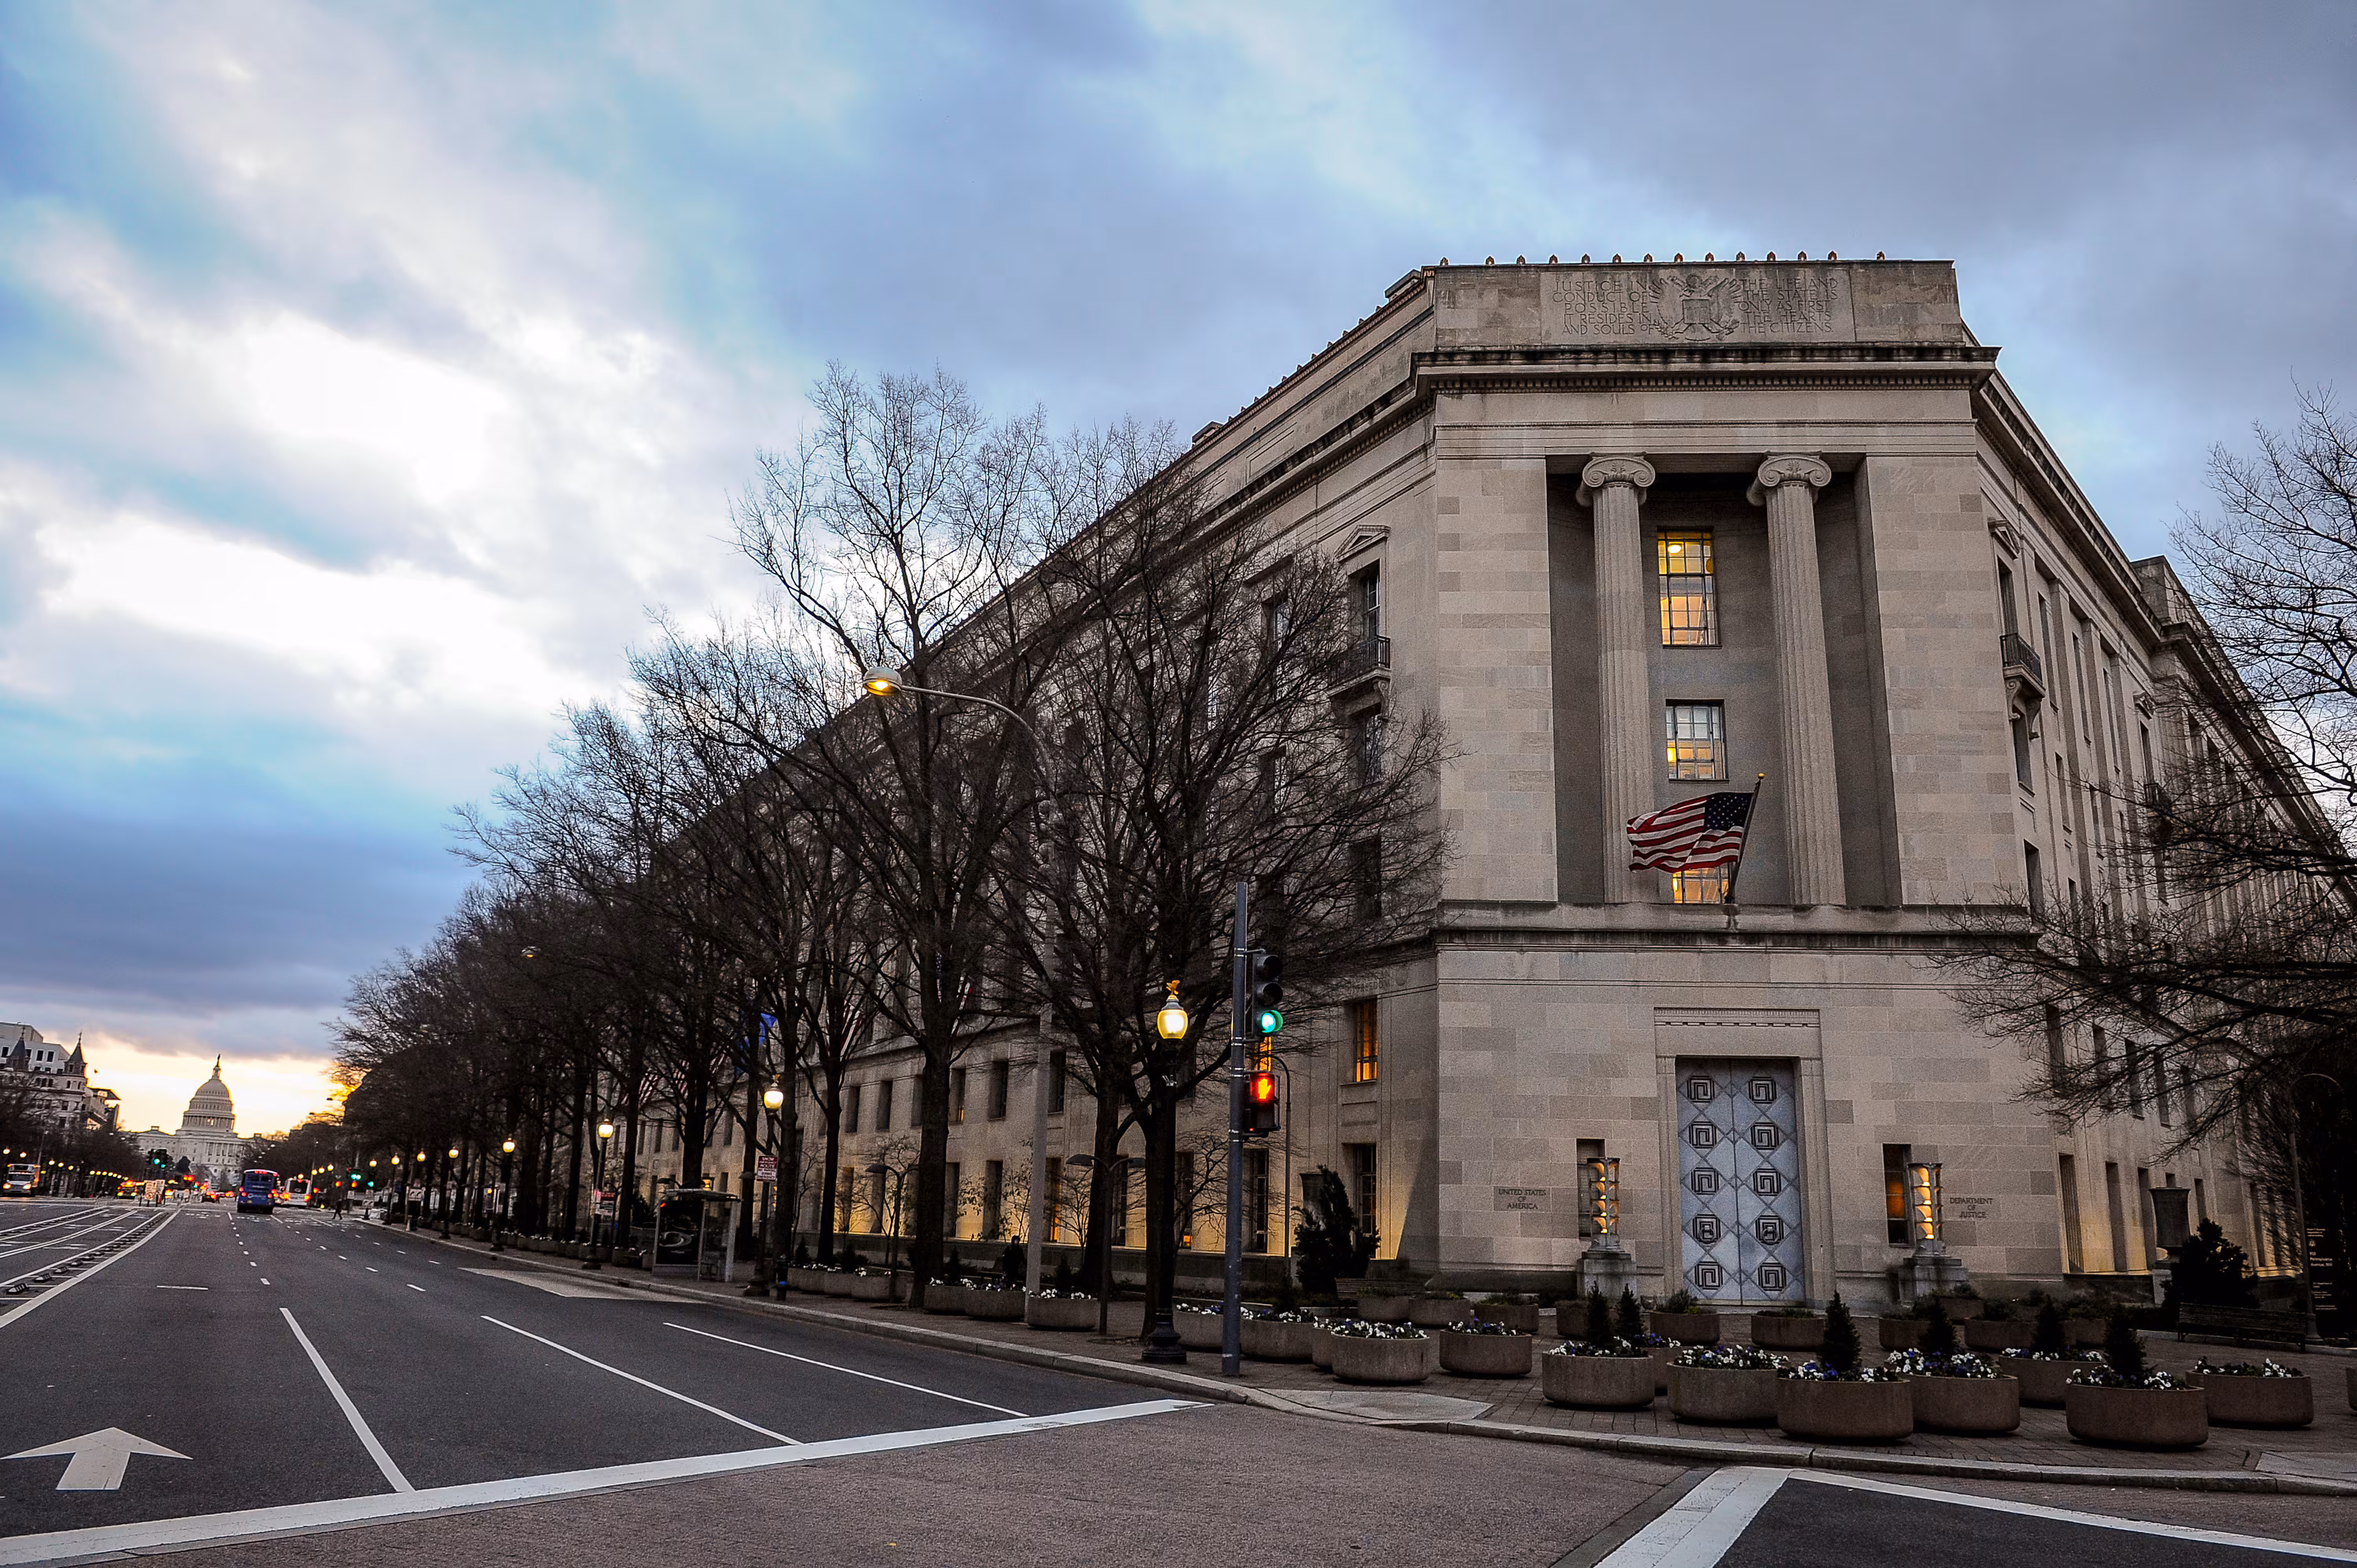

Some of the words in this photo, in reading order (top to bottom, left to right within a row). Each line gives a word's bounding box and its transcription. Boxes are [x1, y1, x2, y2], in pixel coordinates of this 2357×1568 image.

[1552, 280, 1622, 292] JUSTICE
[1630, 280, 1648, 291] IN
[1739, 279, 1767, 290] THE
[1776, 278, 1802, 290] LIFE
[1809, 278, 1838, 289] AND
[1552, 291, 1624, 303] CONDUCT
[1629, 291, 1648, 302] OF
[1743, 290, 1770, 301] THE
[1777, 289, 1818, 301] STATE
[1826, 289, 1838, 300] IS
[1564, 302, 1649, 313] POSSIBLE
[1739, 300, 1772, 312] ONLY
[1776, 300, 1793, 311] AS
[1798, 300, 1831, 311] FIRST
[1563, 313, 1574, 324] IT
[1580, 313, 1633, 324] RESIDES
[1639, 313, 1652, 324] IN
[1743, 311, 1771, 323] THE
[1780, 311, 1831, 323] HEARTS
[1561, 324, 1588, 335] AND
[1593, 324, 1635, 335] SOULS
[1640, 324, 1656, 335] OF
[1739, 322, 1766, 334] THE
